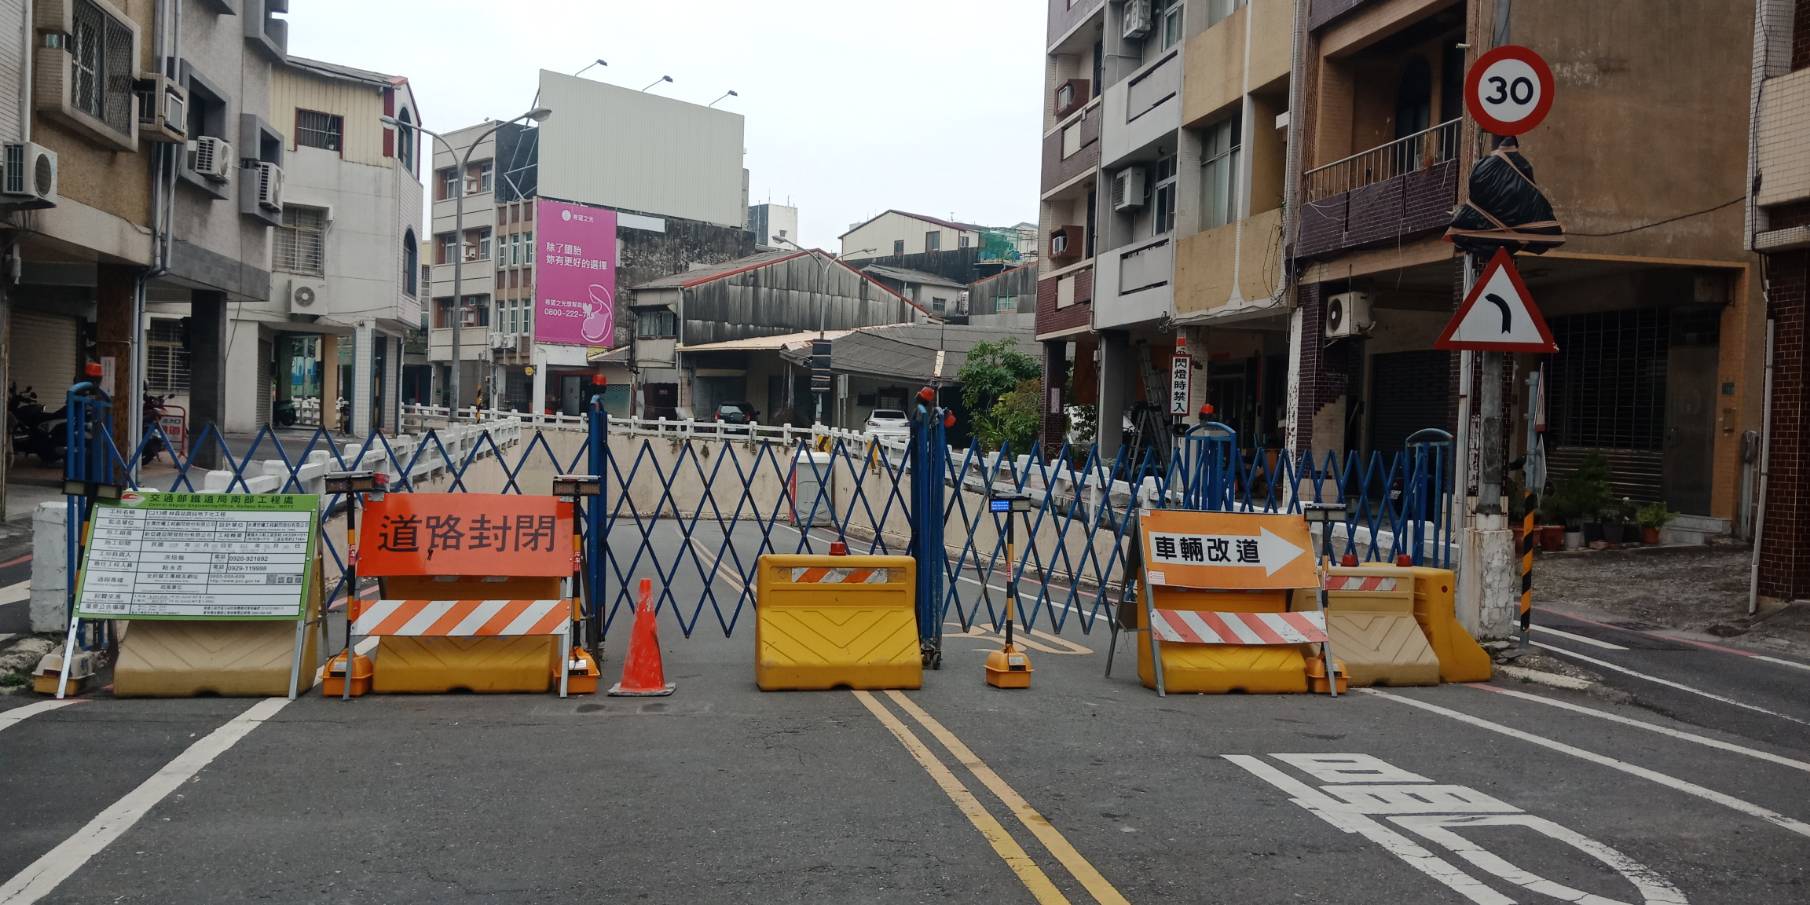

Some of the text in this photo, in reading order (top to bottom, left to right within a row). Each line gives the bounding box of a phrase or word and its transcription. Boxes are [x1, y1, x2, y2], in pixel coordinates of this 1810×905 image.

[1485, 76, 1534, 105] 30
[546, 242, 582, 256] 除了墮胎
[1173, 358, 1187, 412] 閃燈時禁入
[377, 513, 556, 553] 道路封閉
[1154, 536, 1261, 563] 車輛改道
